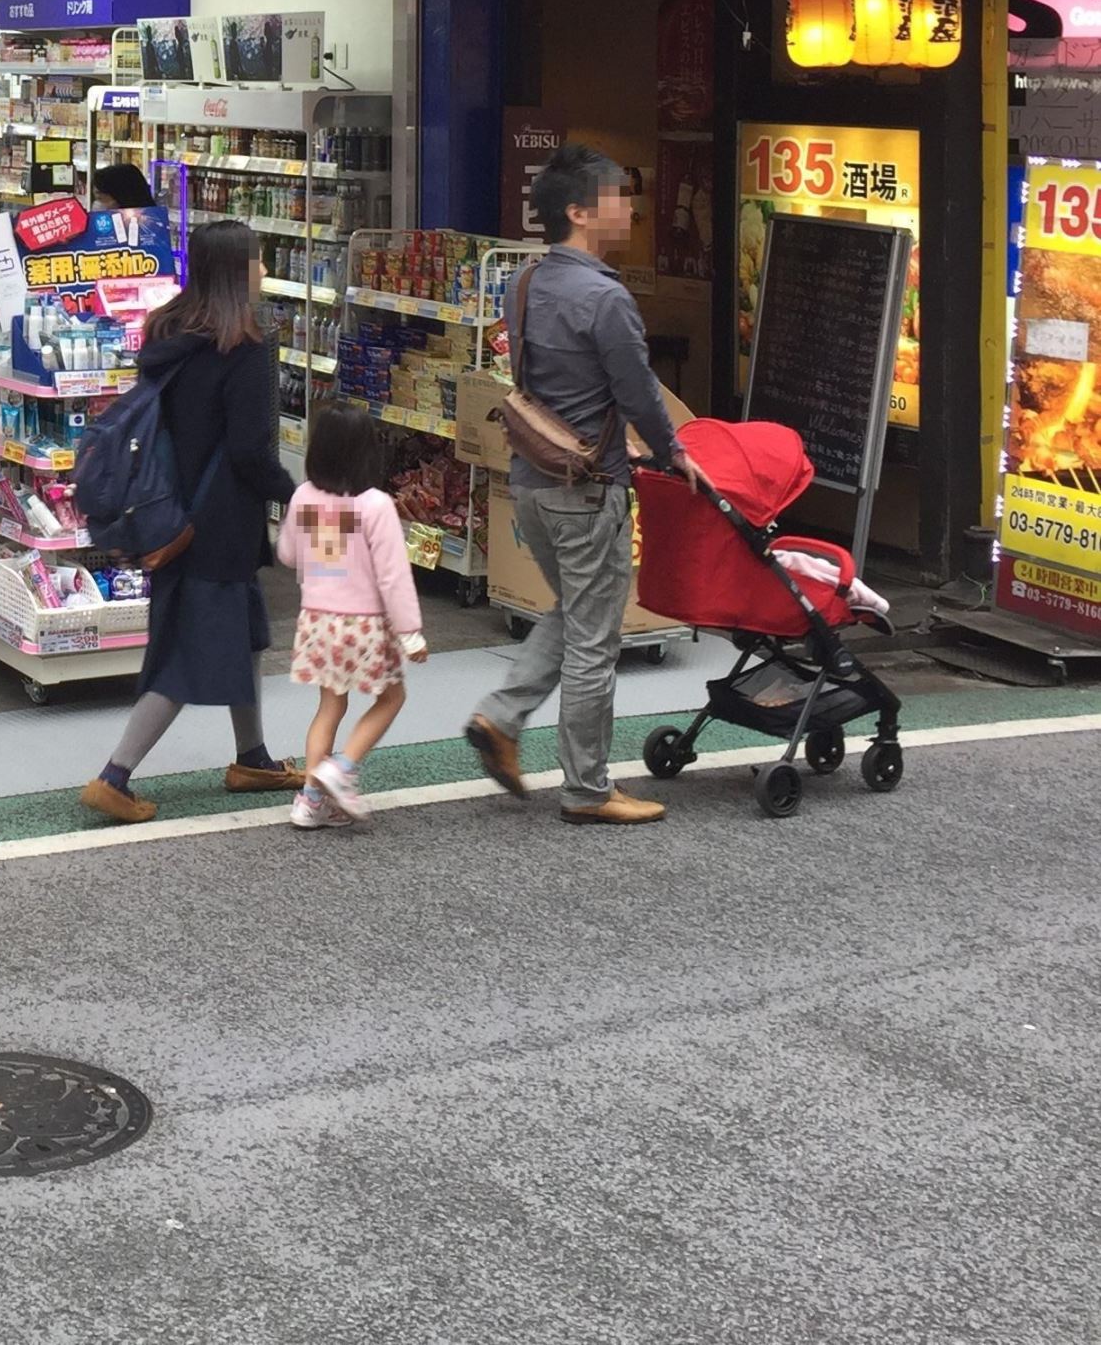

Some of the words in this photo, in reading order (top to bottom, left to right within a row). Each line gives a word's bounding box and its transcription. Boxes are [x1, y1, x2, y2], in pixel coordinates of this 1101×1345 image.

[513, 134, 560, 149] YEBISU
[748, 136, 834, 195] 135
[842, 161, 897, 201] 酒場
[25, 251, 156, 285] 薬用・無添加の
[1009, 510, 1101, 551] 03-5779-81
